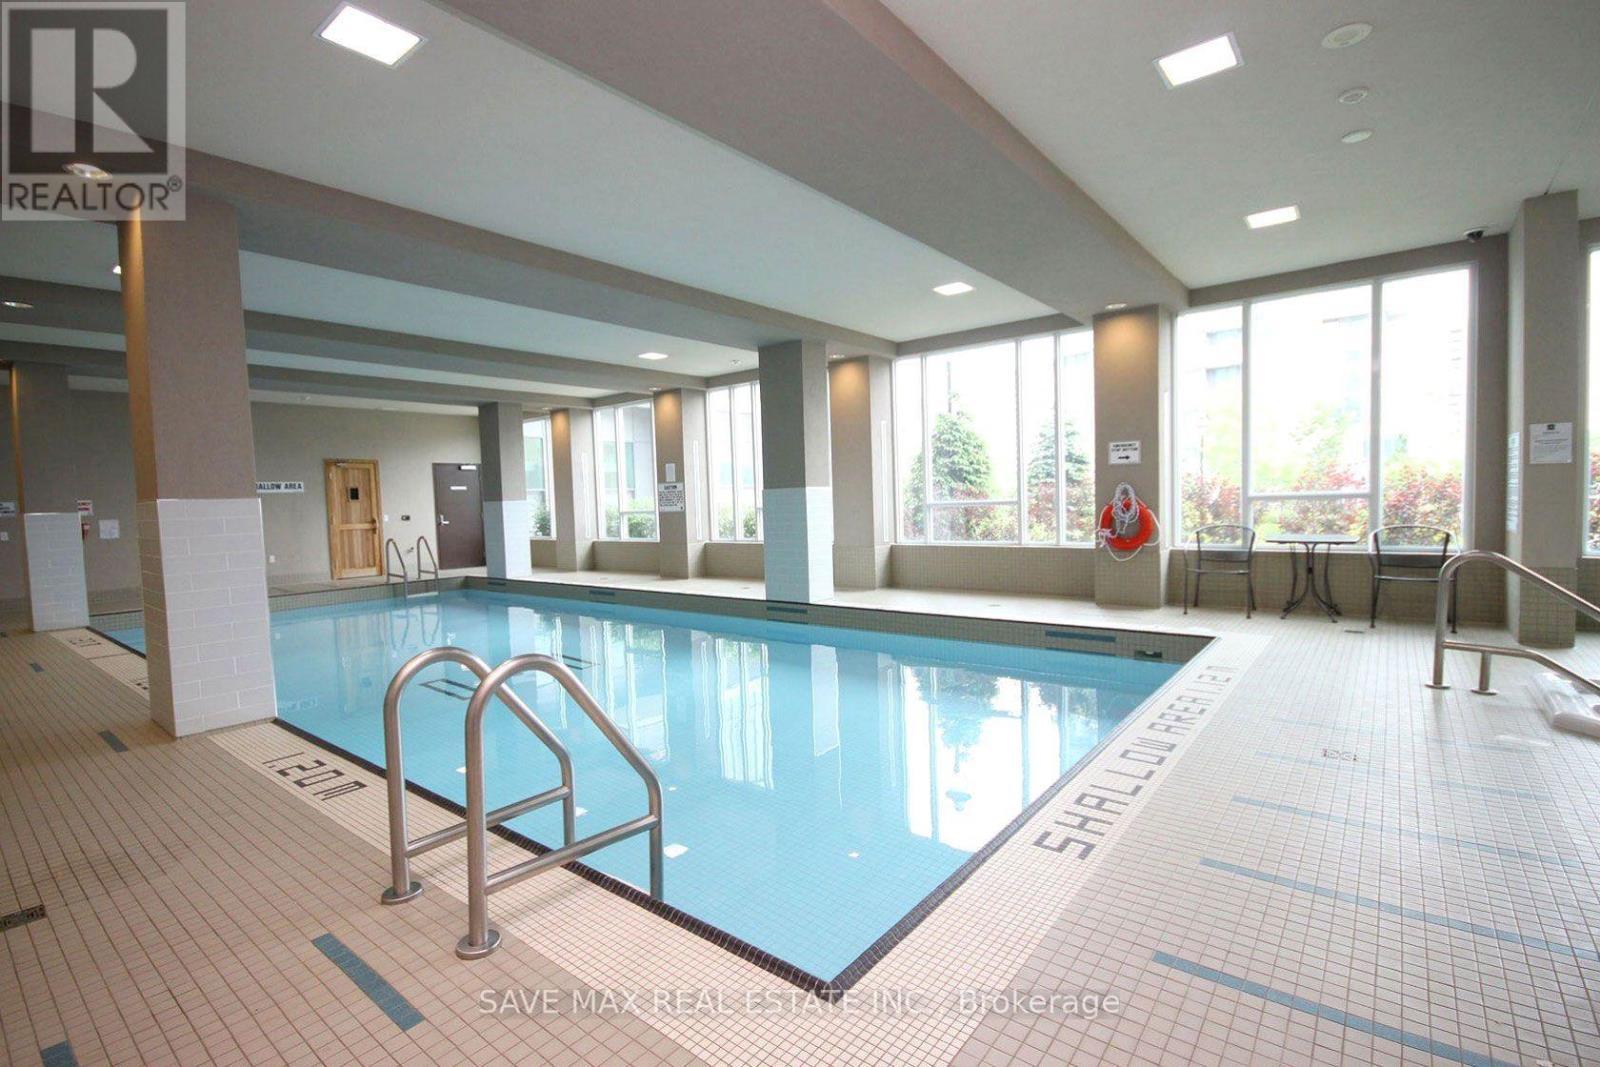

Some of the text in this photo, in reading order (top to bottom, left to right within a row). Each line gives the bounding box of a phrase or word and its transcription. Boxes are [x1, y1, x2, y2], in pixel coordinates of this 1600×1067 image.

[283, 482, 302, 490] AREA
[1032, 736, 1177, 860] SHALLOW
[1147, 695, 1214, 736] AREA
